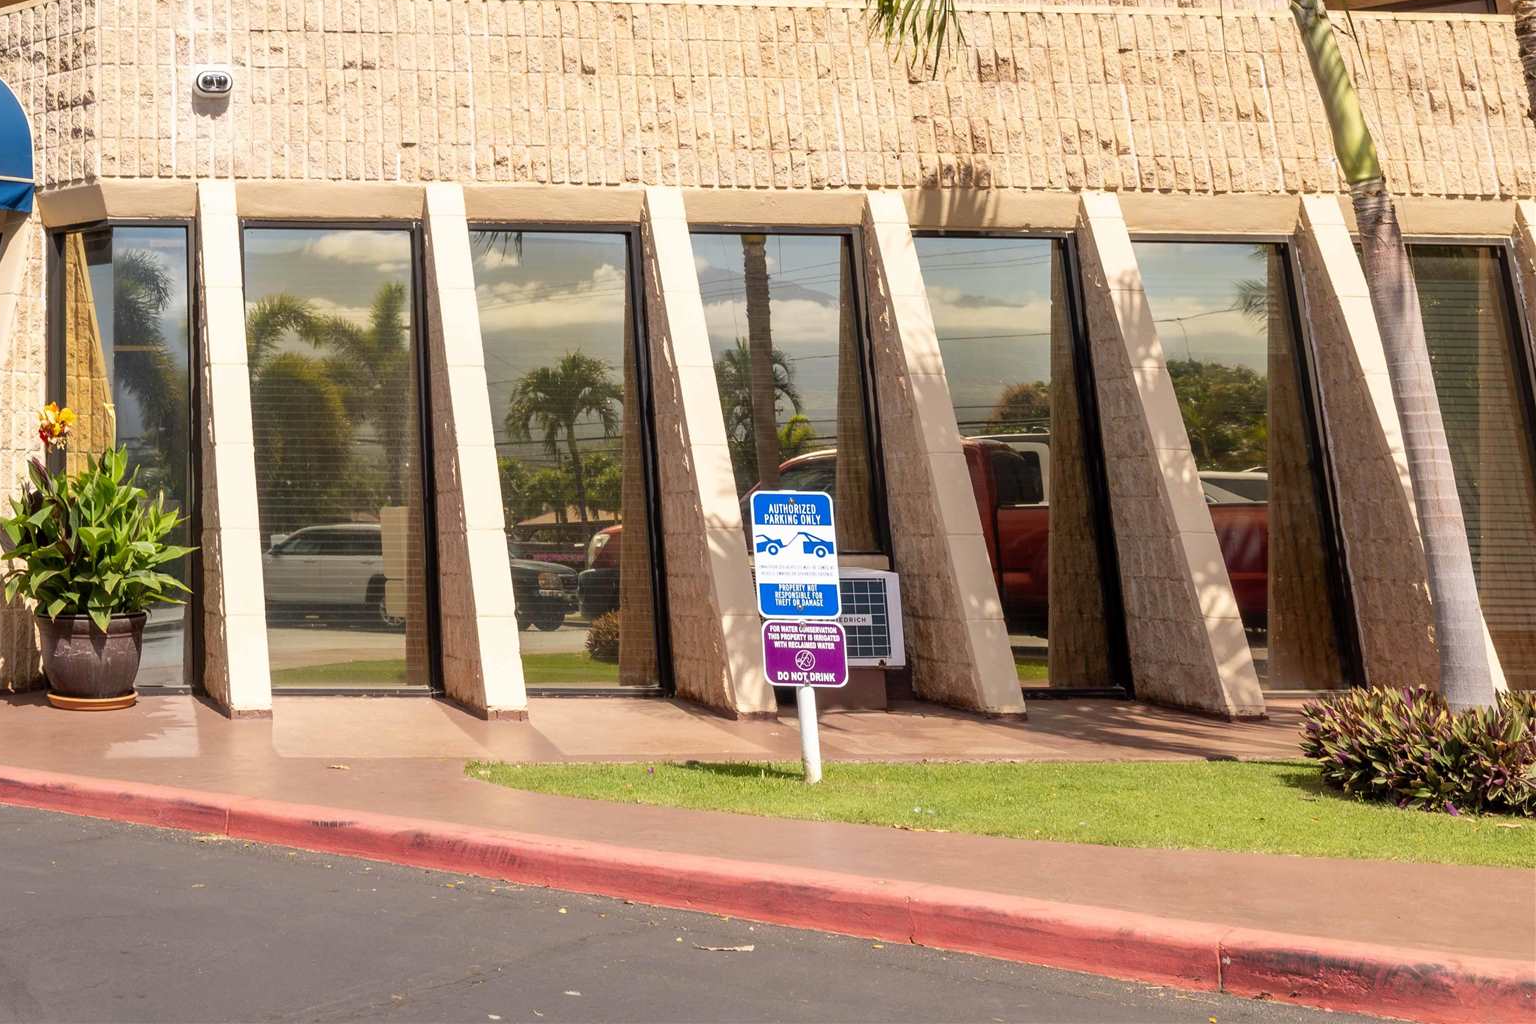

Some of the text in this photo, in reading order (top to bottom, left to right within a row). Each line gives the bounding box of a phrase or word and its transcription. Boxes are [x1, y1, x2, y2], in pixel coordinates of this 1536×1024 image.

[769, 504, 816, 514] AUTHORIZED
[764, 514, 820, 524] PARKING ONLY
[814, 634, 840, 642] IRRIGATED
[777, 672, 836, 682] DO NOT DRINK
